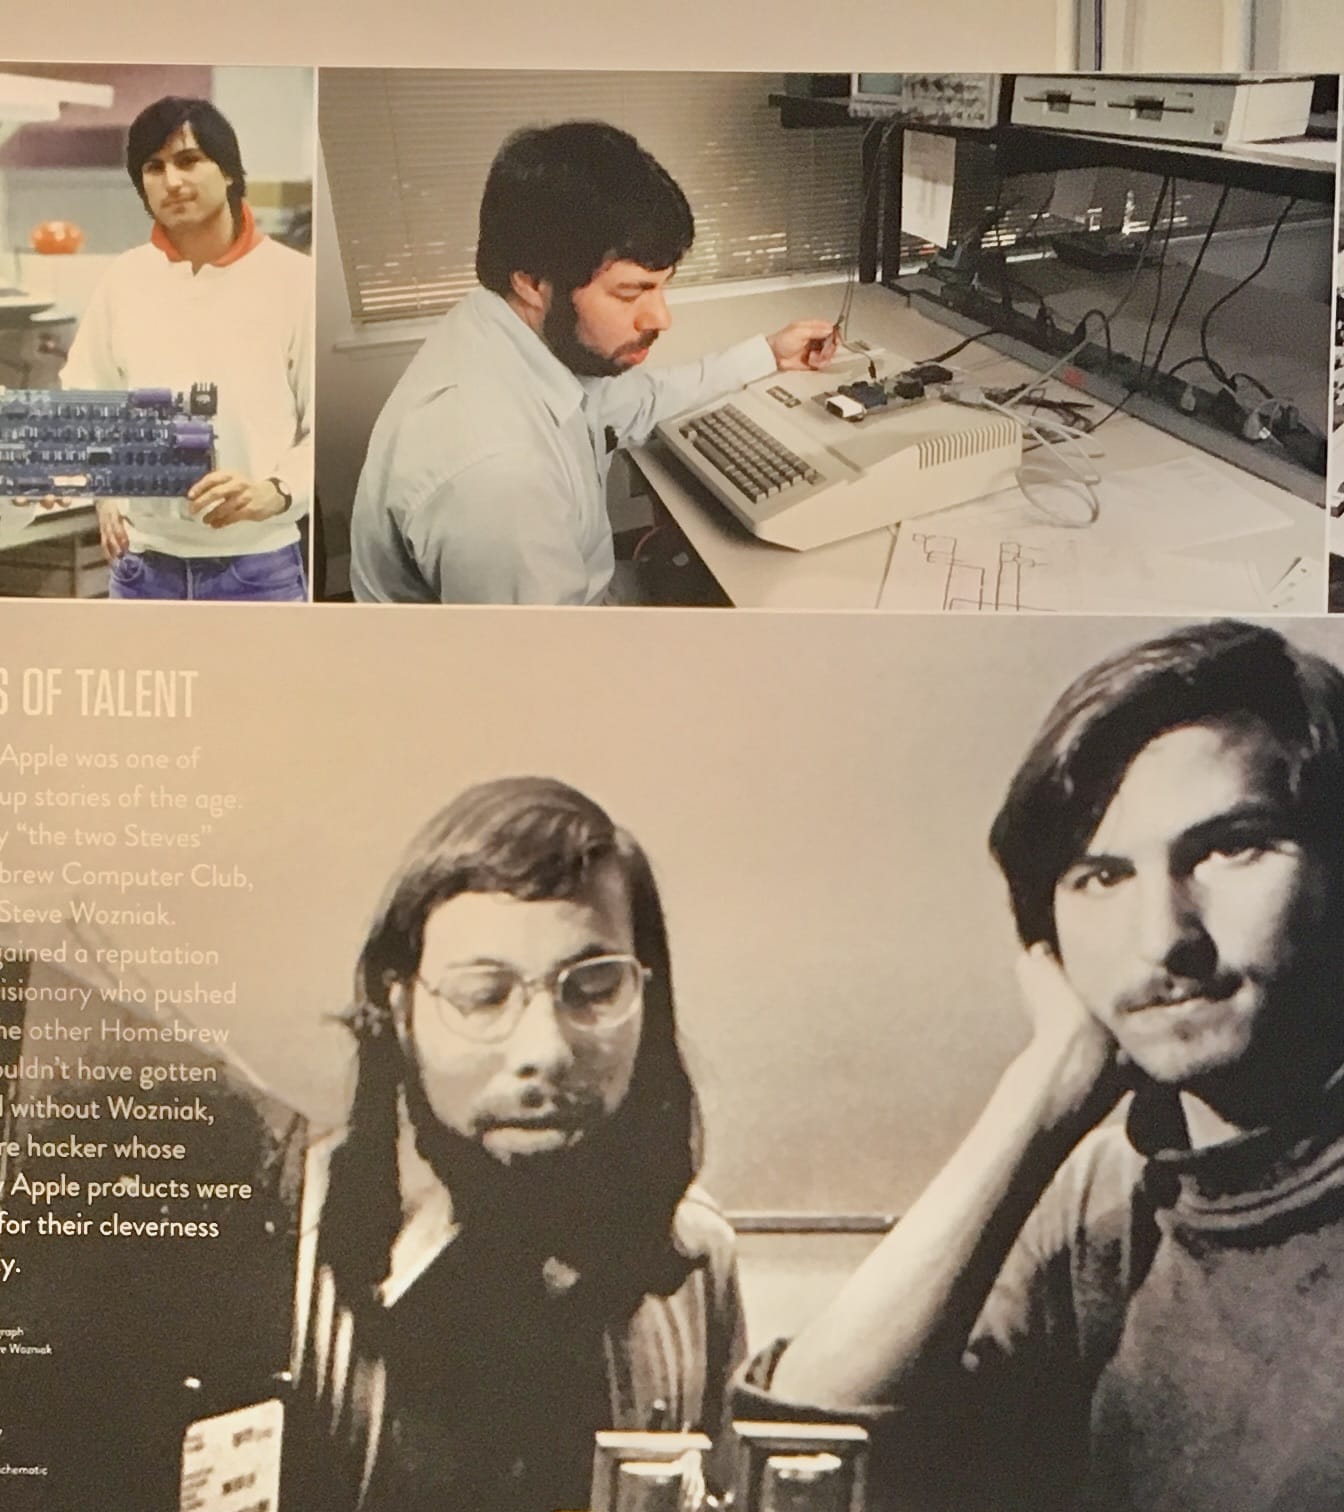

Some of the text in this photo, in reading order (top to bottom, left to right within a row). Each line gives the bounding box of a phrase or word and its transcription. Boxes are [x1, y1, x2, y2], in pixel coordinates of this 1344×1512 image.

[23, 667, 62, 716] OF
[75, 669, 199, 718] TALENT
[75, 753, 119, 768] was
[126, 753, 170, 769] one
[176, 745, 202, 769] of
[74, 828, 116, 846] two
[62, 861, 184, 894] Computer
[190, 863, 254, 892] Club,
[69, 901, 175, 927] Wozniak.
[74, 949, 88, 963] a
[96, 943, 219, 973] reputation
[29, 1018, 93, 1041] other
[101, 1018, 228, 1042] Homebrew
[11, 1095, 100, 1119] without
[107, 1096, 214, 1125] Wozniak,
[28, 1134, 107, 1157] hacker
[114, 1135, 185, 1159] whose
[10, 1172, 80, 1204] Apple
[88, 1174, 189, 1205] products
[196, 1184, 251, 1199] were
[38, 1212, 93, 1235] their
[99, 1213, 219, 1237] cleverness
